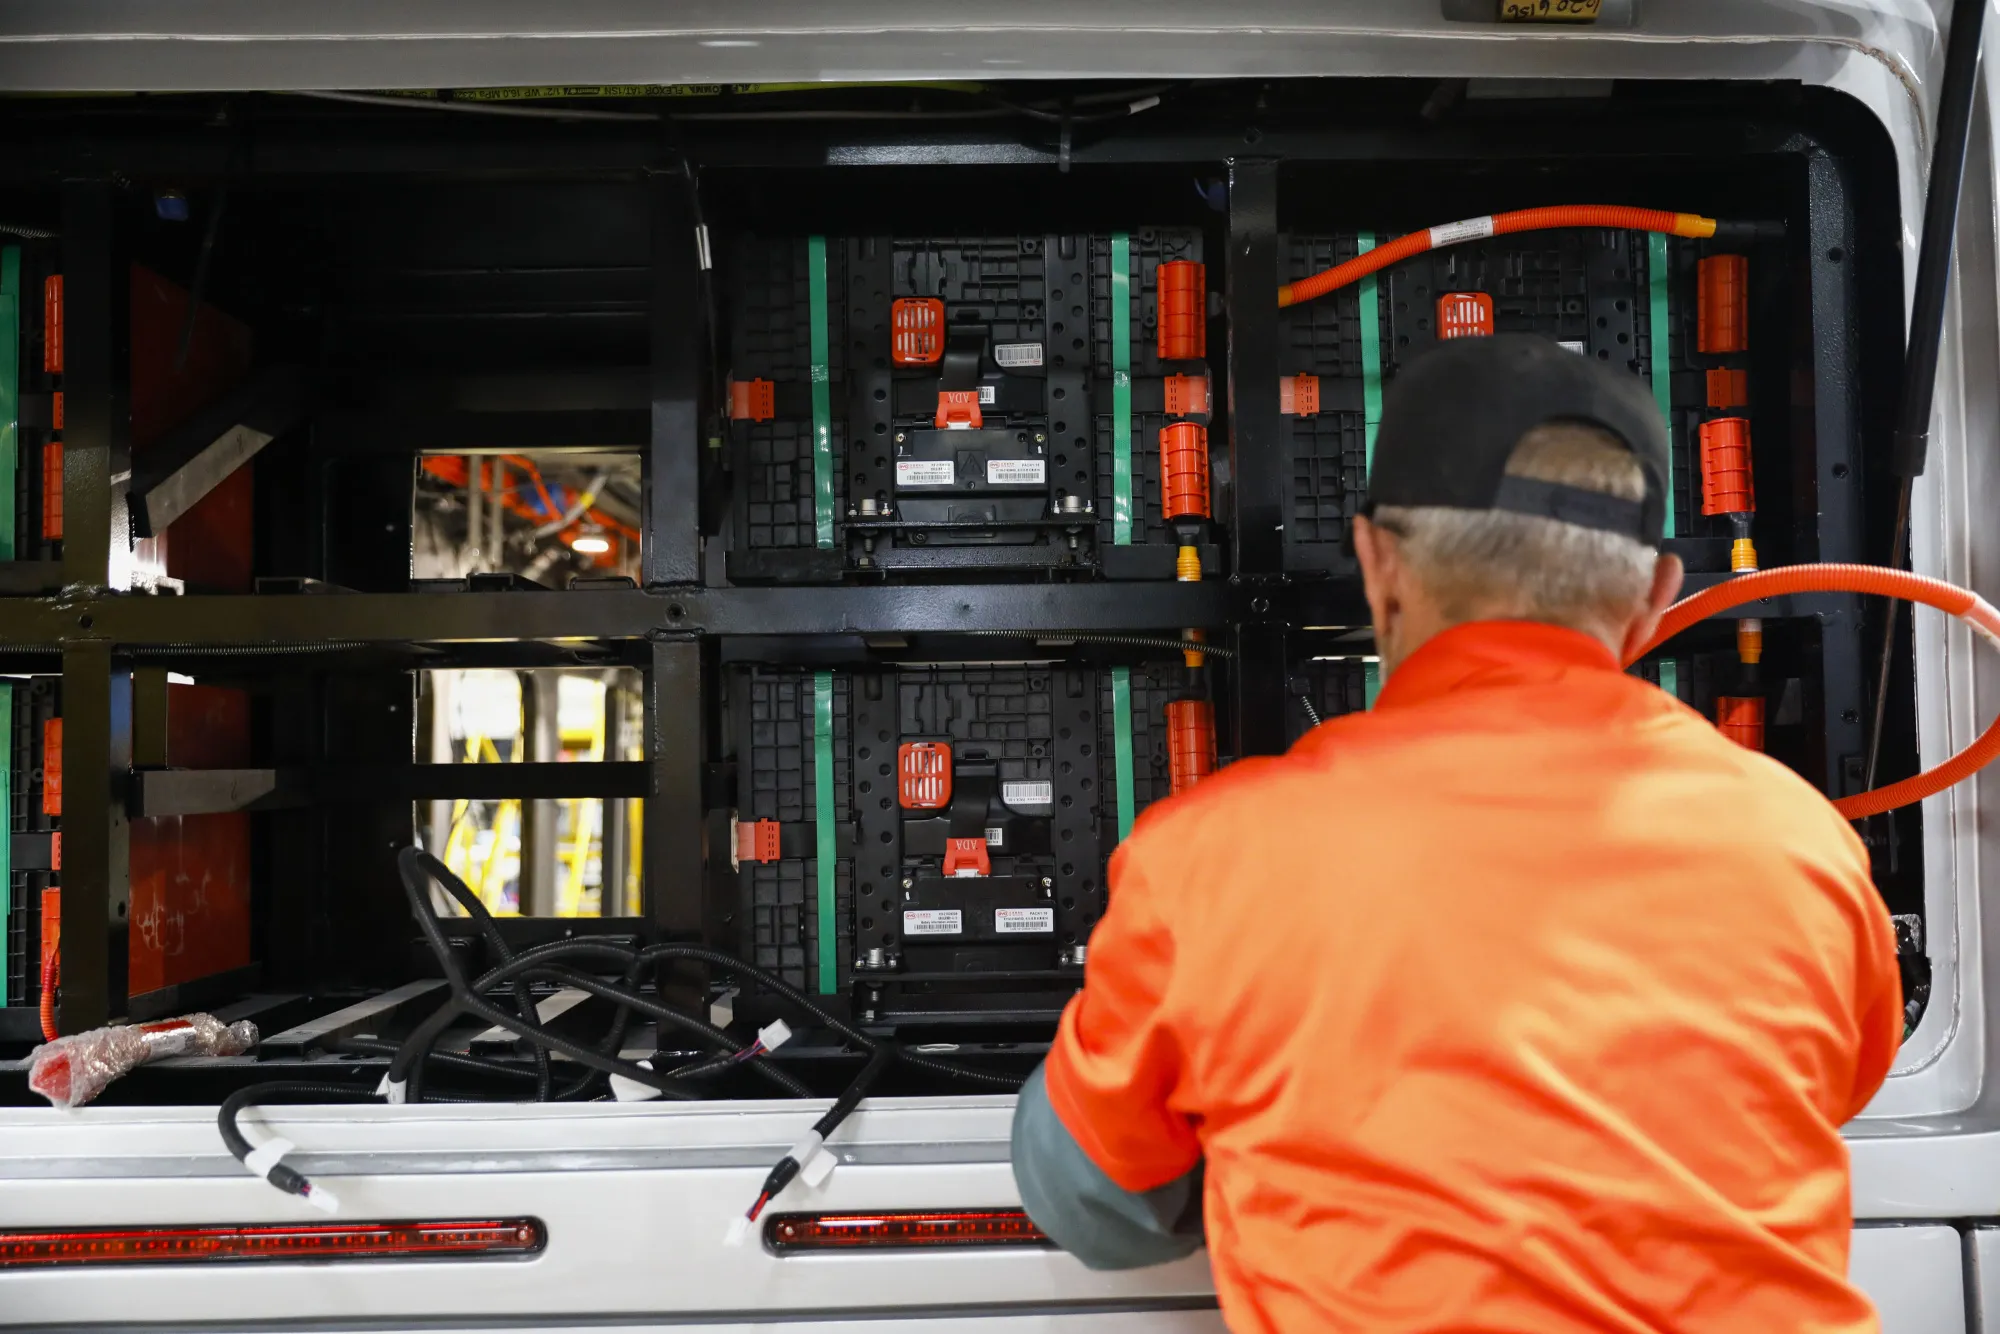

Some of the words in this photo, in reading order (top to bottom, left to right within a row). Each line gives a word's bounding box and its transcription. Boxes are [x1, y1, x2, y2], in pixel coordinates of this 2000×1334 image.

[479, 91, 501, 99] MPa
[502, 89, 521, 98] 16.0
[524, 88, 540, 97] WP
[604, 86, 642, 95] 1AT/1SN
[645, 86, 683, 95] FLEXOR
[948, 392, 969, 404] ADA
[956, 840, 977, 851] ADA
